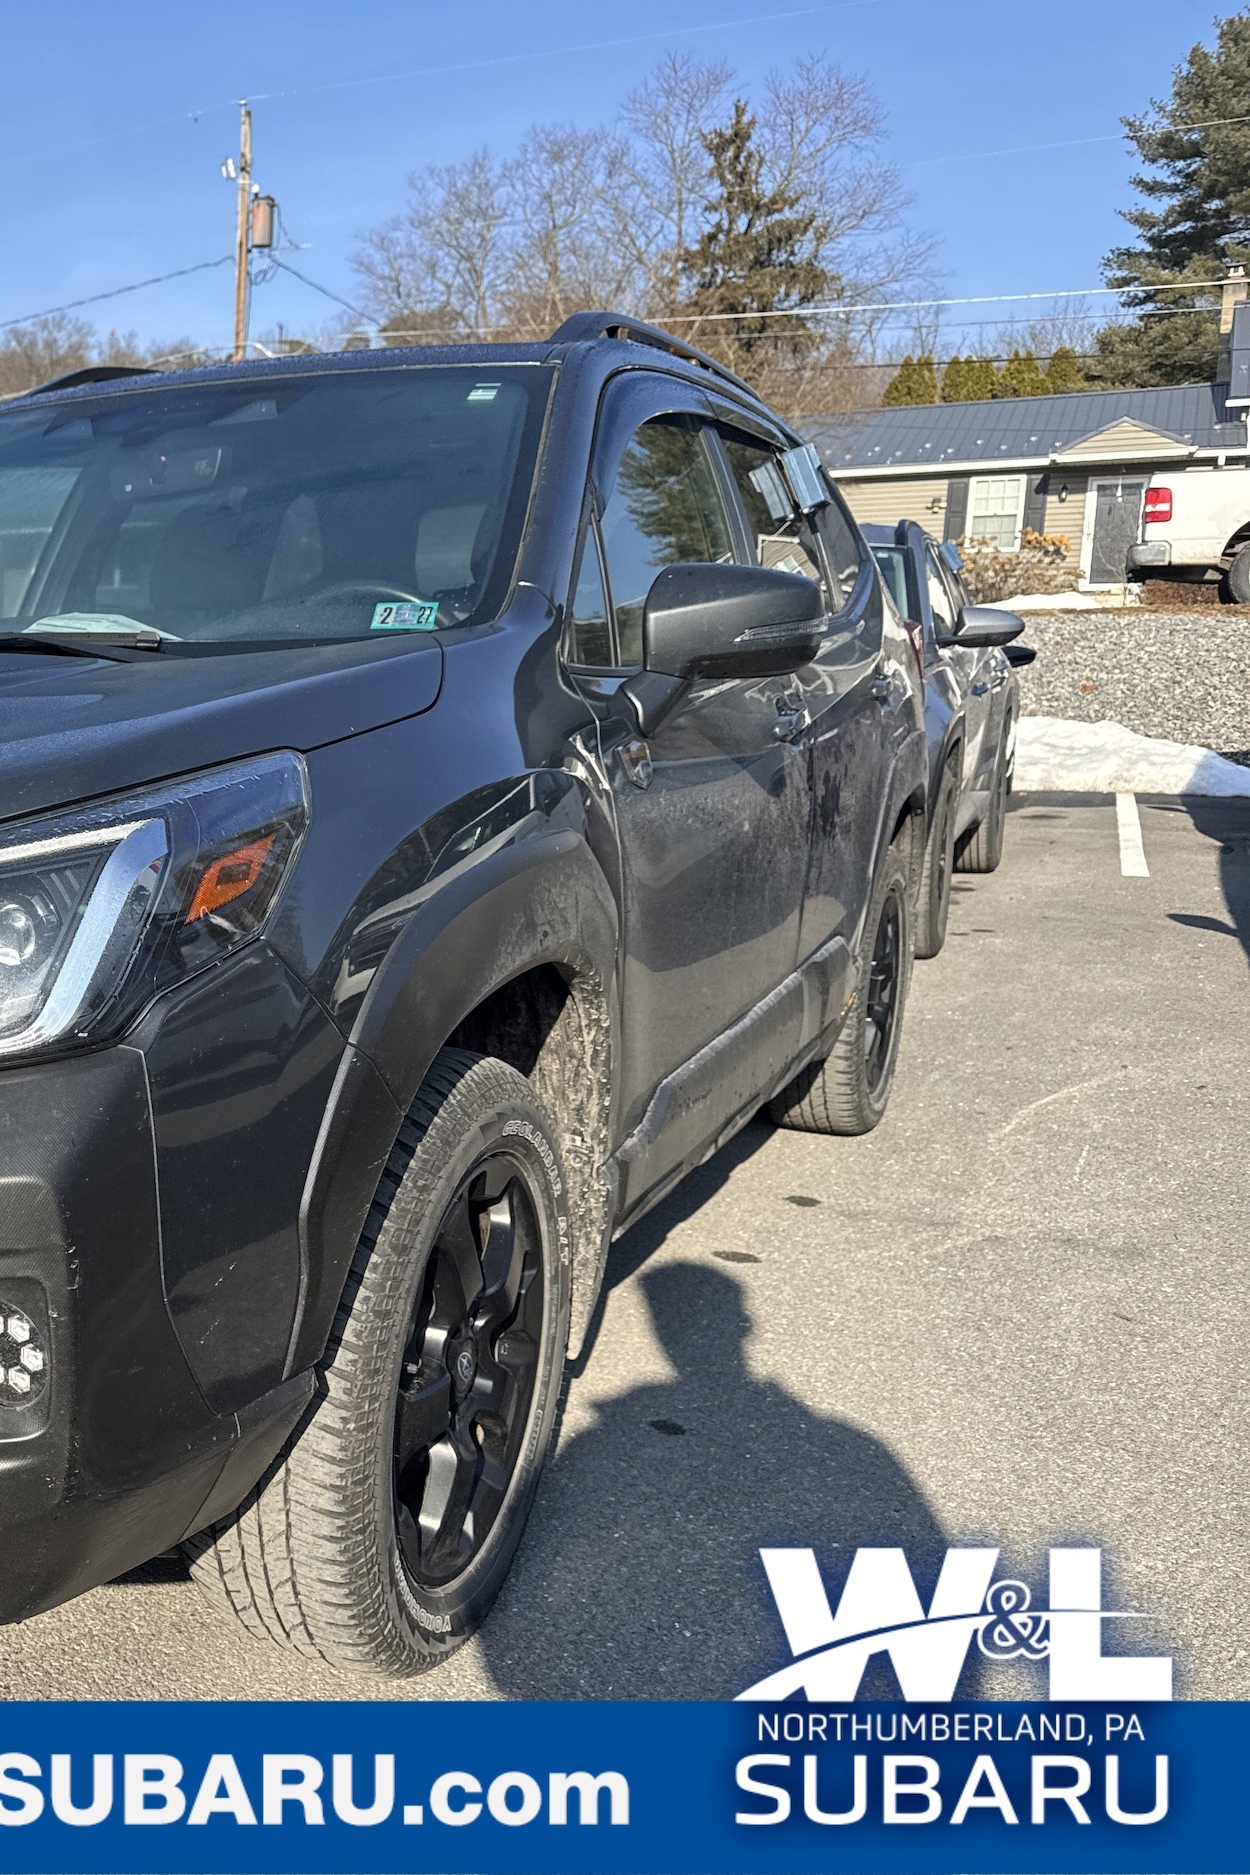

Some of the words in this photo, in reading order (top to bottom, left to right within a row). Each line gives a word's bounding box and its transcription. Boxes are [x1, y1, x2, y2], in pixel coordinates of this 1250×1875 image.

[380, 607, 393, 625] 2
[417, 606, 434, 624] 27
[502, 1120, 562, 1198] GEOLANDAR
[394, 1549, 452, 1633] YOKOHAMA
